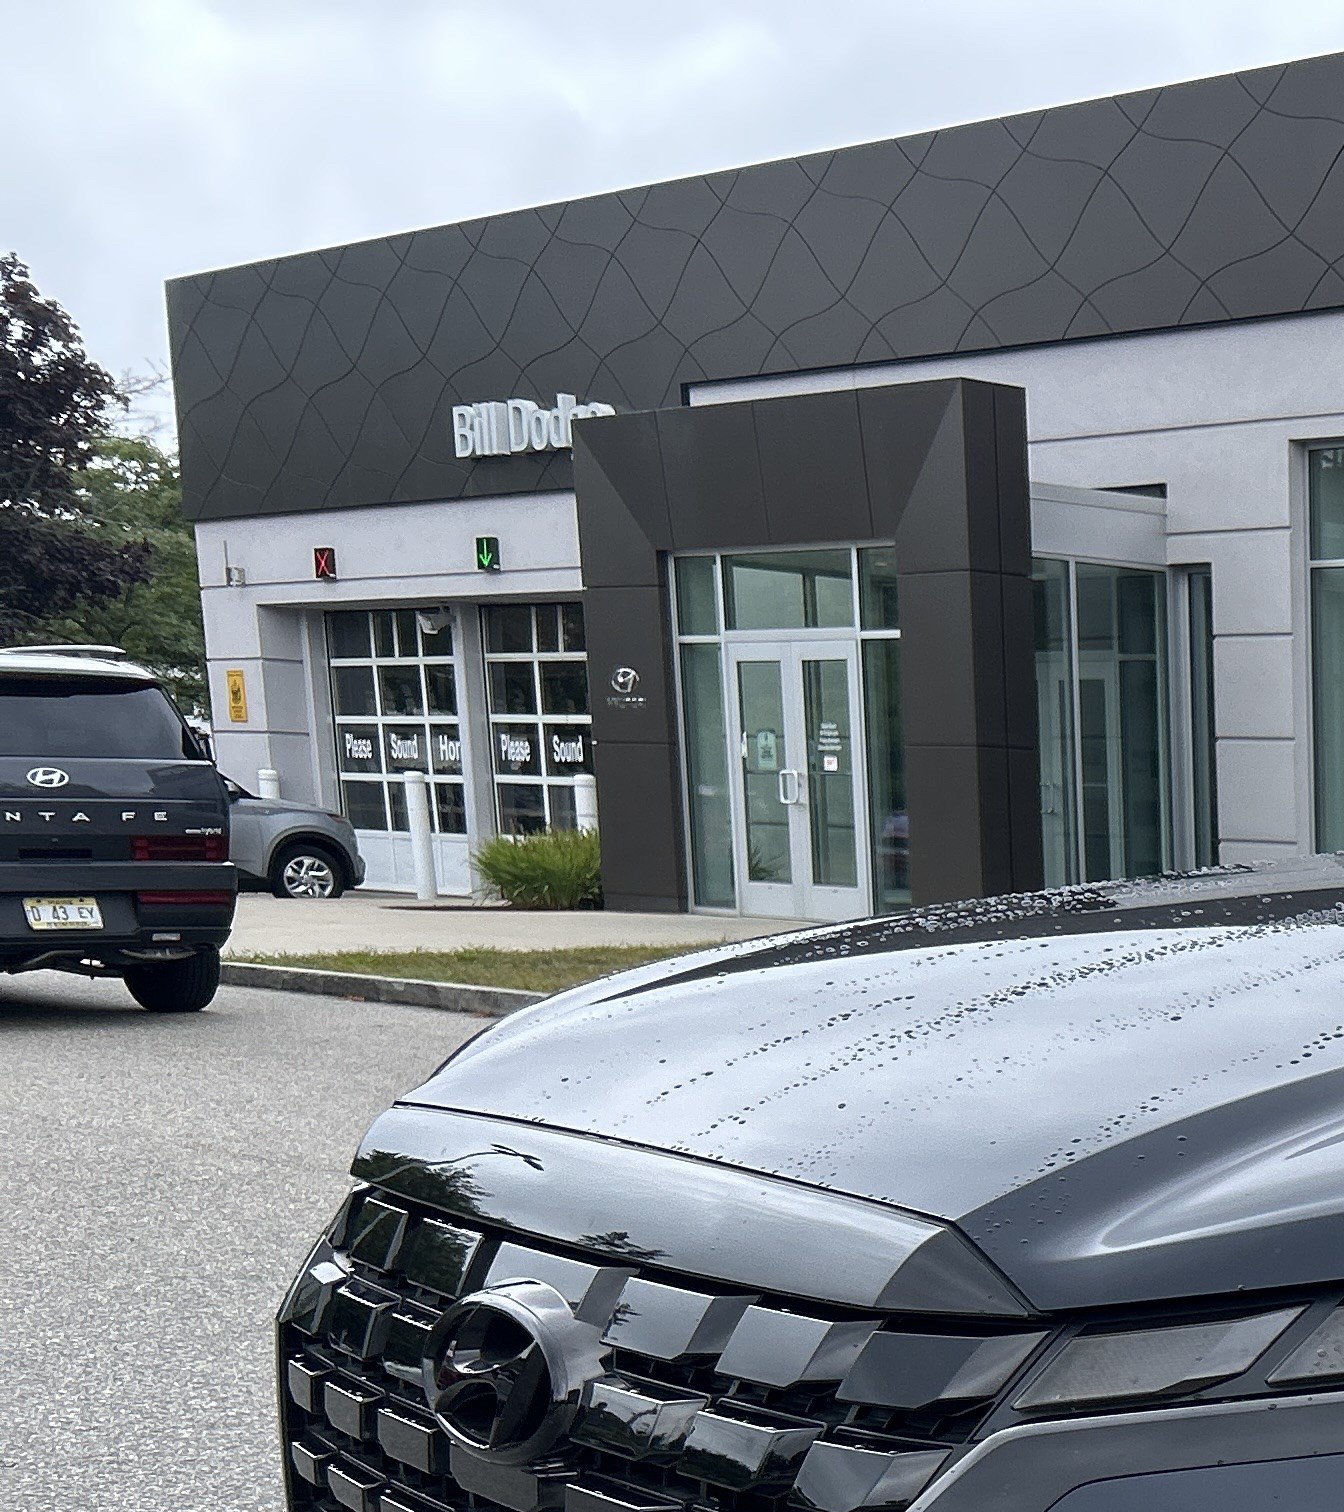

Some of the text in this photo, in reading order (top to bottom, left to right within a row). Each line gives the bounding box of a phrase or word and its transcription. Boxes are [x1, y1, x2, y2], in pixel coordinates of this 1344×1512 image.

[452, 393, 616, 458] Bill Dod
[344, 733, 461, 761] Please Sound Hor
[501, 734, 584, 763] Please Sound
[121, 811, 168, 822] FE
